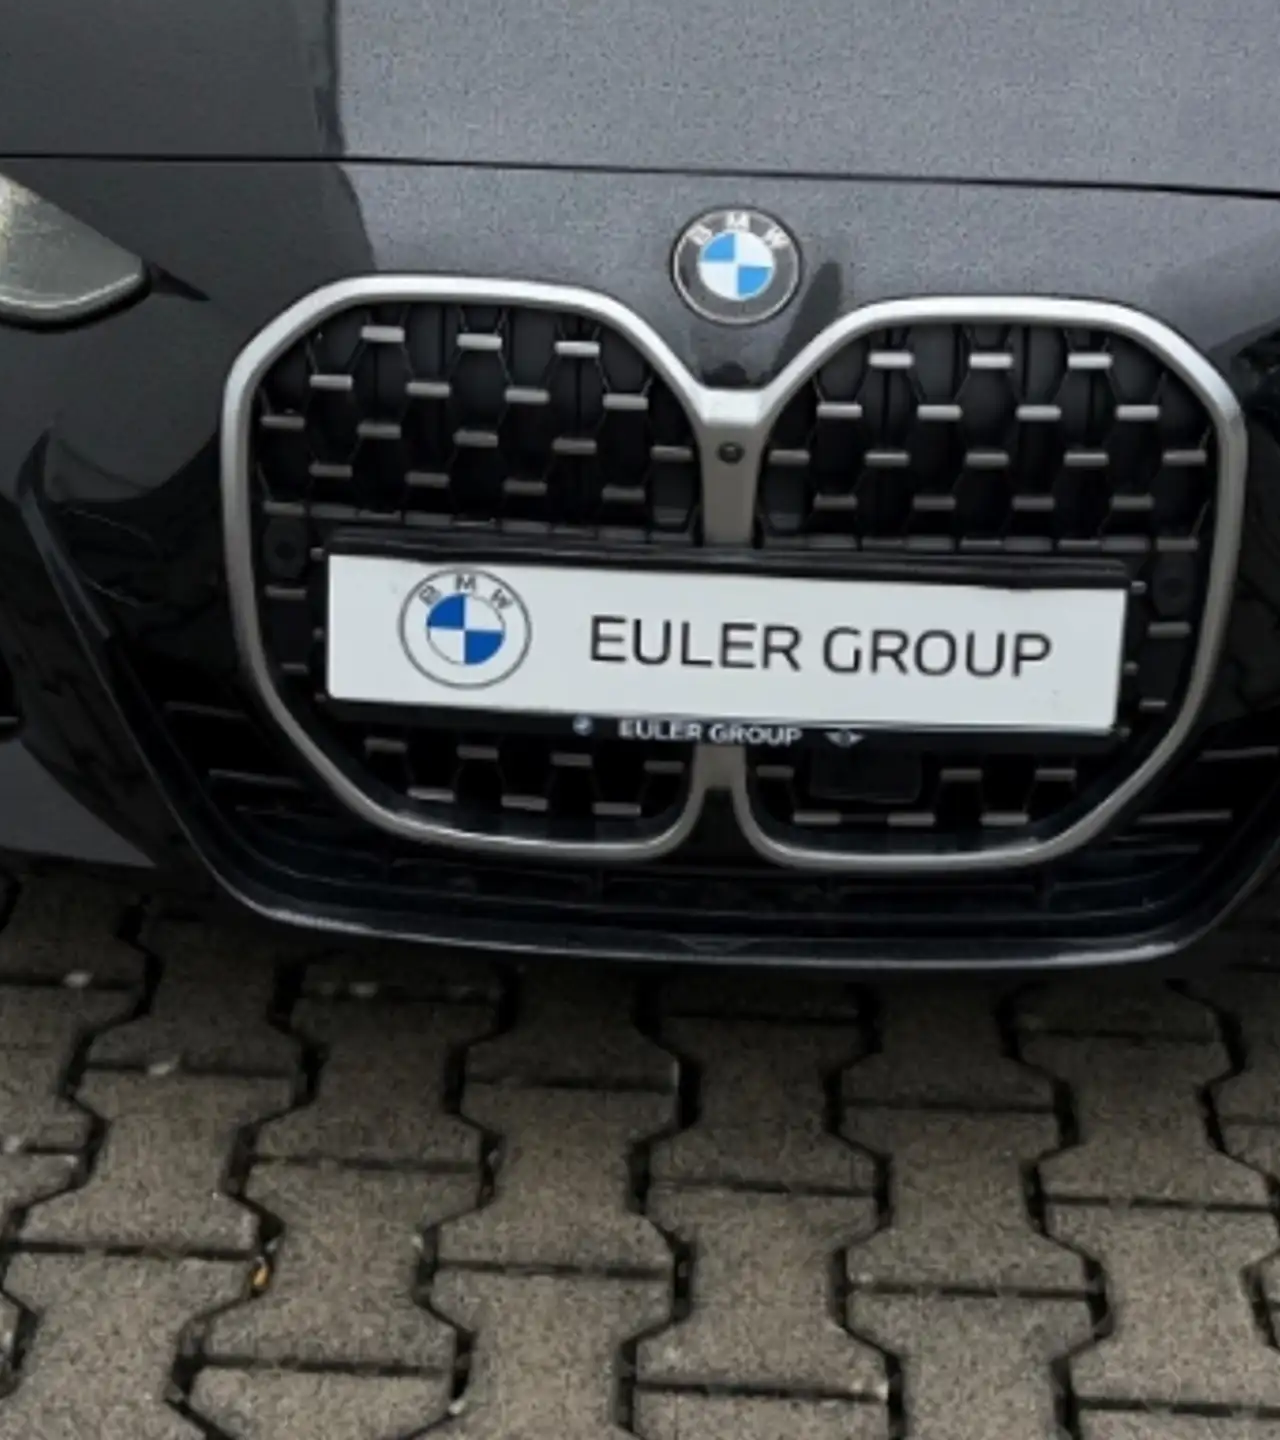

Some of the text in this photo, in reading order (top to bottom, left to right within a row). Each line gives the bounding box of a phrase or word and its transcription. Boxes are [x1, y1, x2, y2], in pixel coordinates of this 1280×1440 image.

[687, 211, 789, 248] BMW
[419, 574, 513, 609] BMW
[589, 614, 1053, 679] EULER GROUP
[618, 718, 803, 746] EULER GROUP
